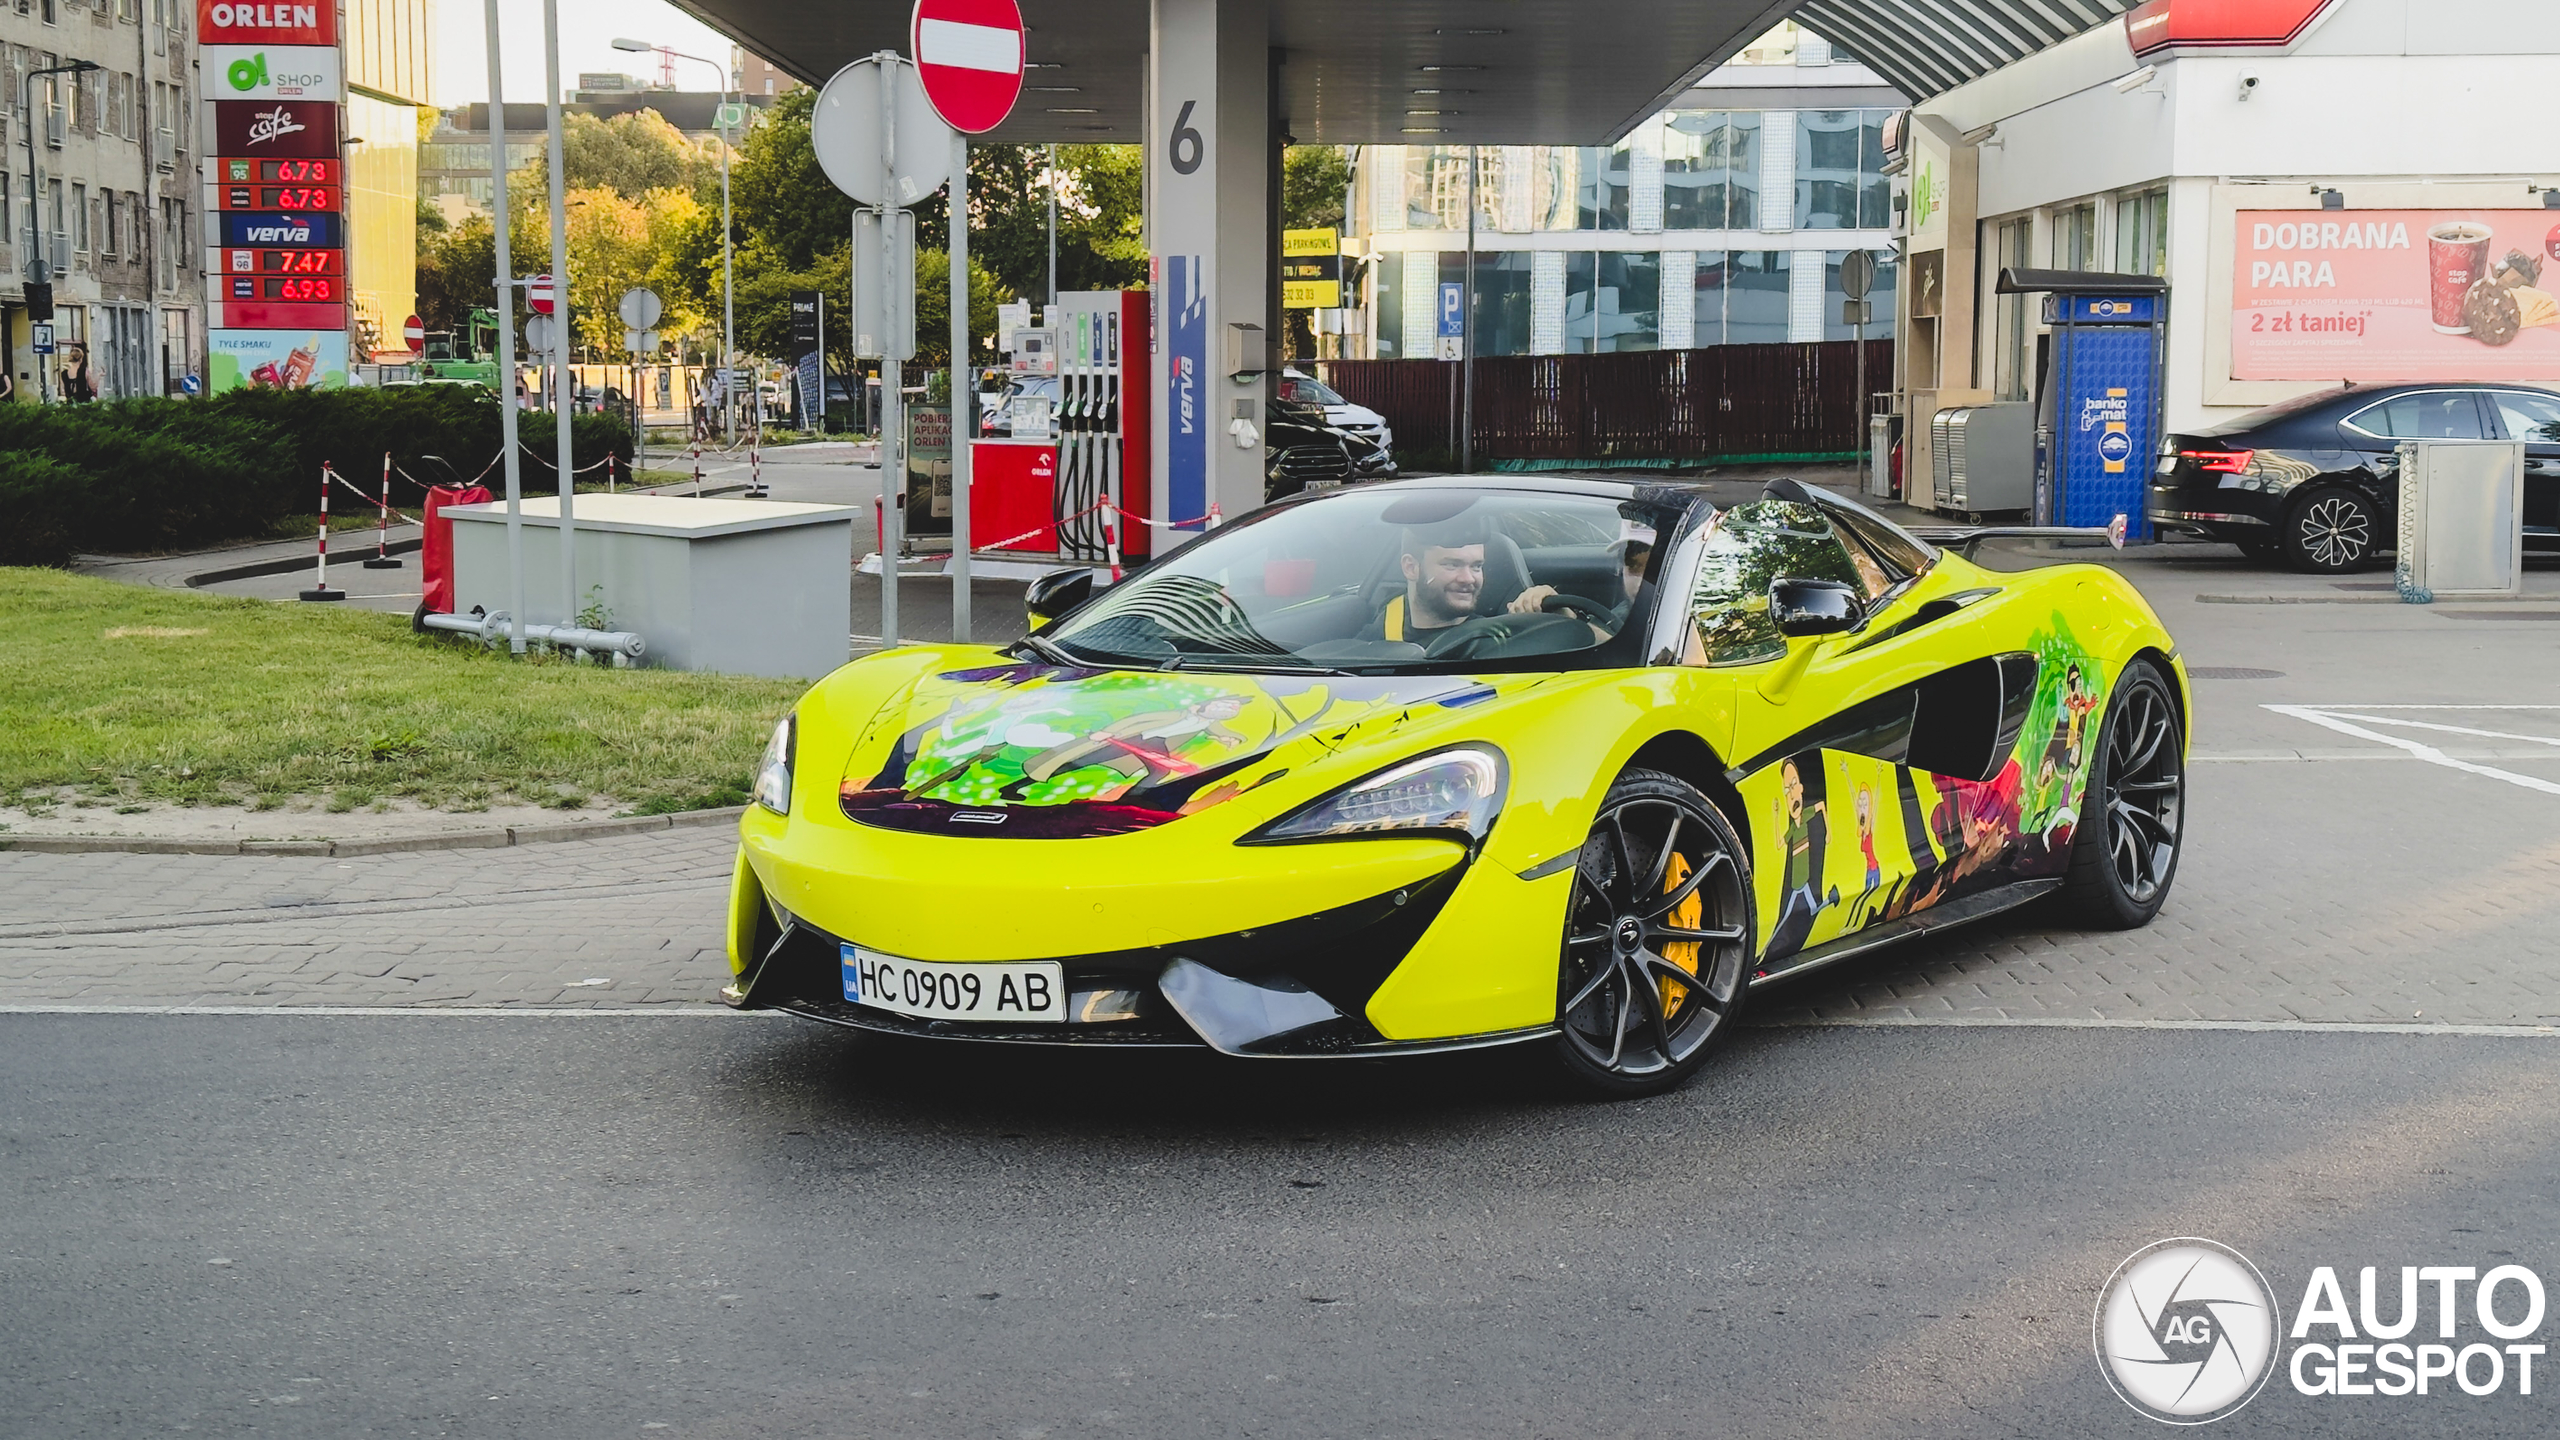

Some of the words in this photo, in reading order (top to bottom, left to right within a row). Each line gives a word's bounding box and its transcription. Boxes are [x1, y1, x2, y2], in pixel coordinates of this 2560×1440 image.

[211, 3, 317, 28] ORLEN
[277, 74, 323, 87] SHOP
[1169, 100, 1204, 176] 6
[233, 169, 247, 179] 95
[278, 161, 326, 180] 6.73
[279, 188, 327, 209] 6.73
[246, 227, 310, 242] verva
[2253, 222, 2411, 251] DOBRANA
[236, 260, 249, 270] 98
[281, 252, 330, 272] 7.47
[2251, 260, 2337, 289] PARA
[2448, 269, 2468, 278] stop
[2448, 276, 2467, 285] cafe
[281, 279, 330, 300] 6.93
[2251, 312, 2264, 332] 2
[2271, 310, 2293, 332] zł
[218, 340, 238, 348] TYLE
[240, 340, 272, 349] SMAKU
[1180, 356, 1194, 434] verva
[2086, 397, 2127, 410] banko
[2101, 409, 2126, 421] mat
[914, 437, 946, 447] ORLEN
[1031, 467, 1052, 477] ORLEN
[845, 979, 858, 994] UA
[858, 958, 898, 1002] HC
[903, 968, 981, 1012] 0909
[997, 973, 1052, 1012] AB
